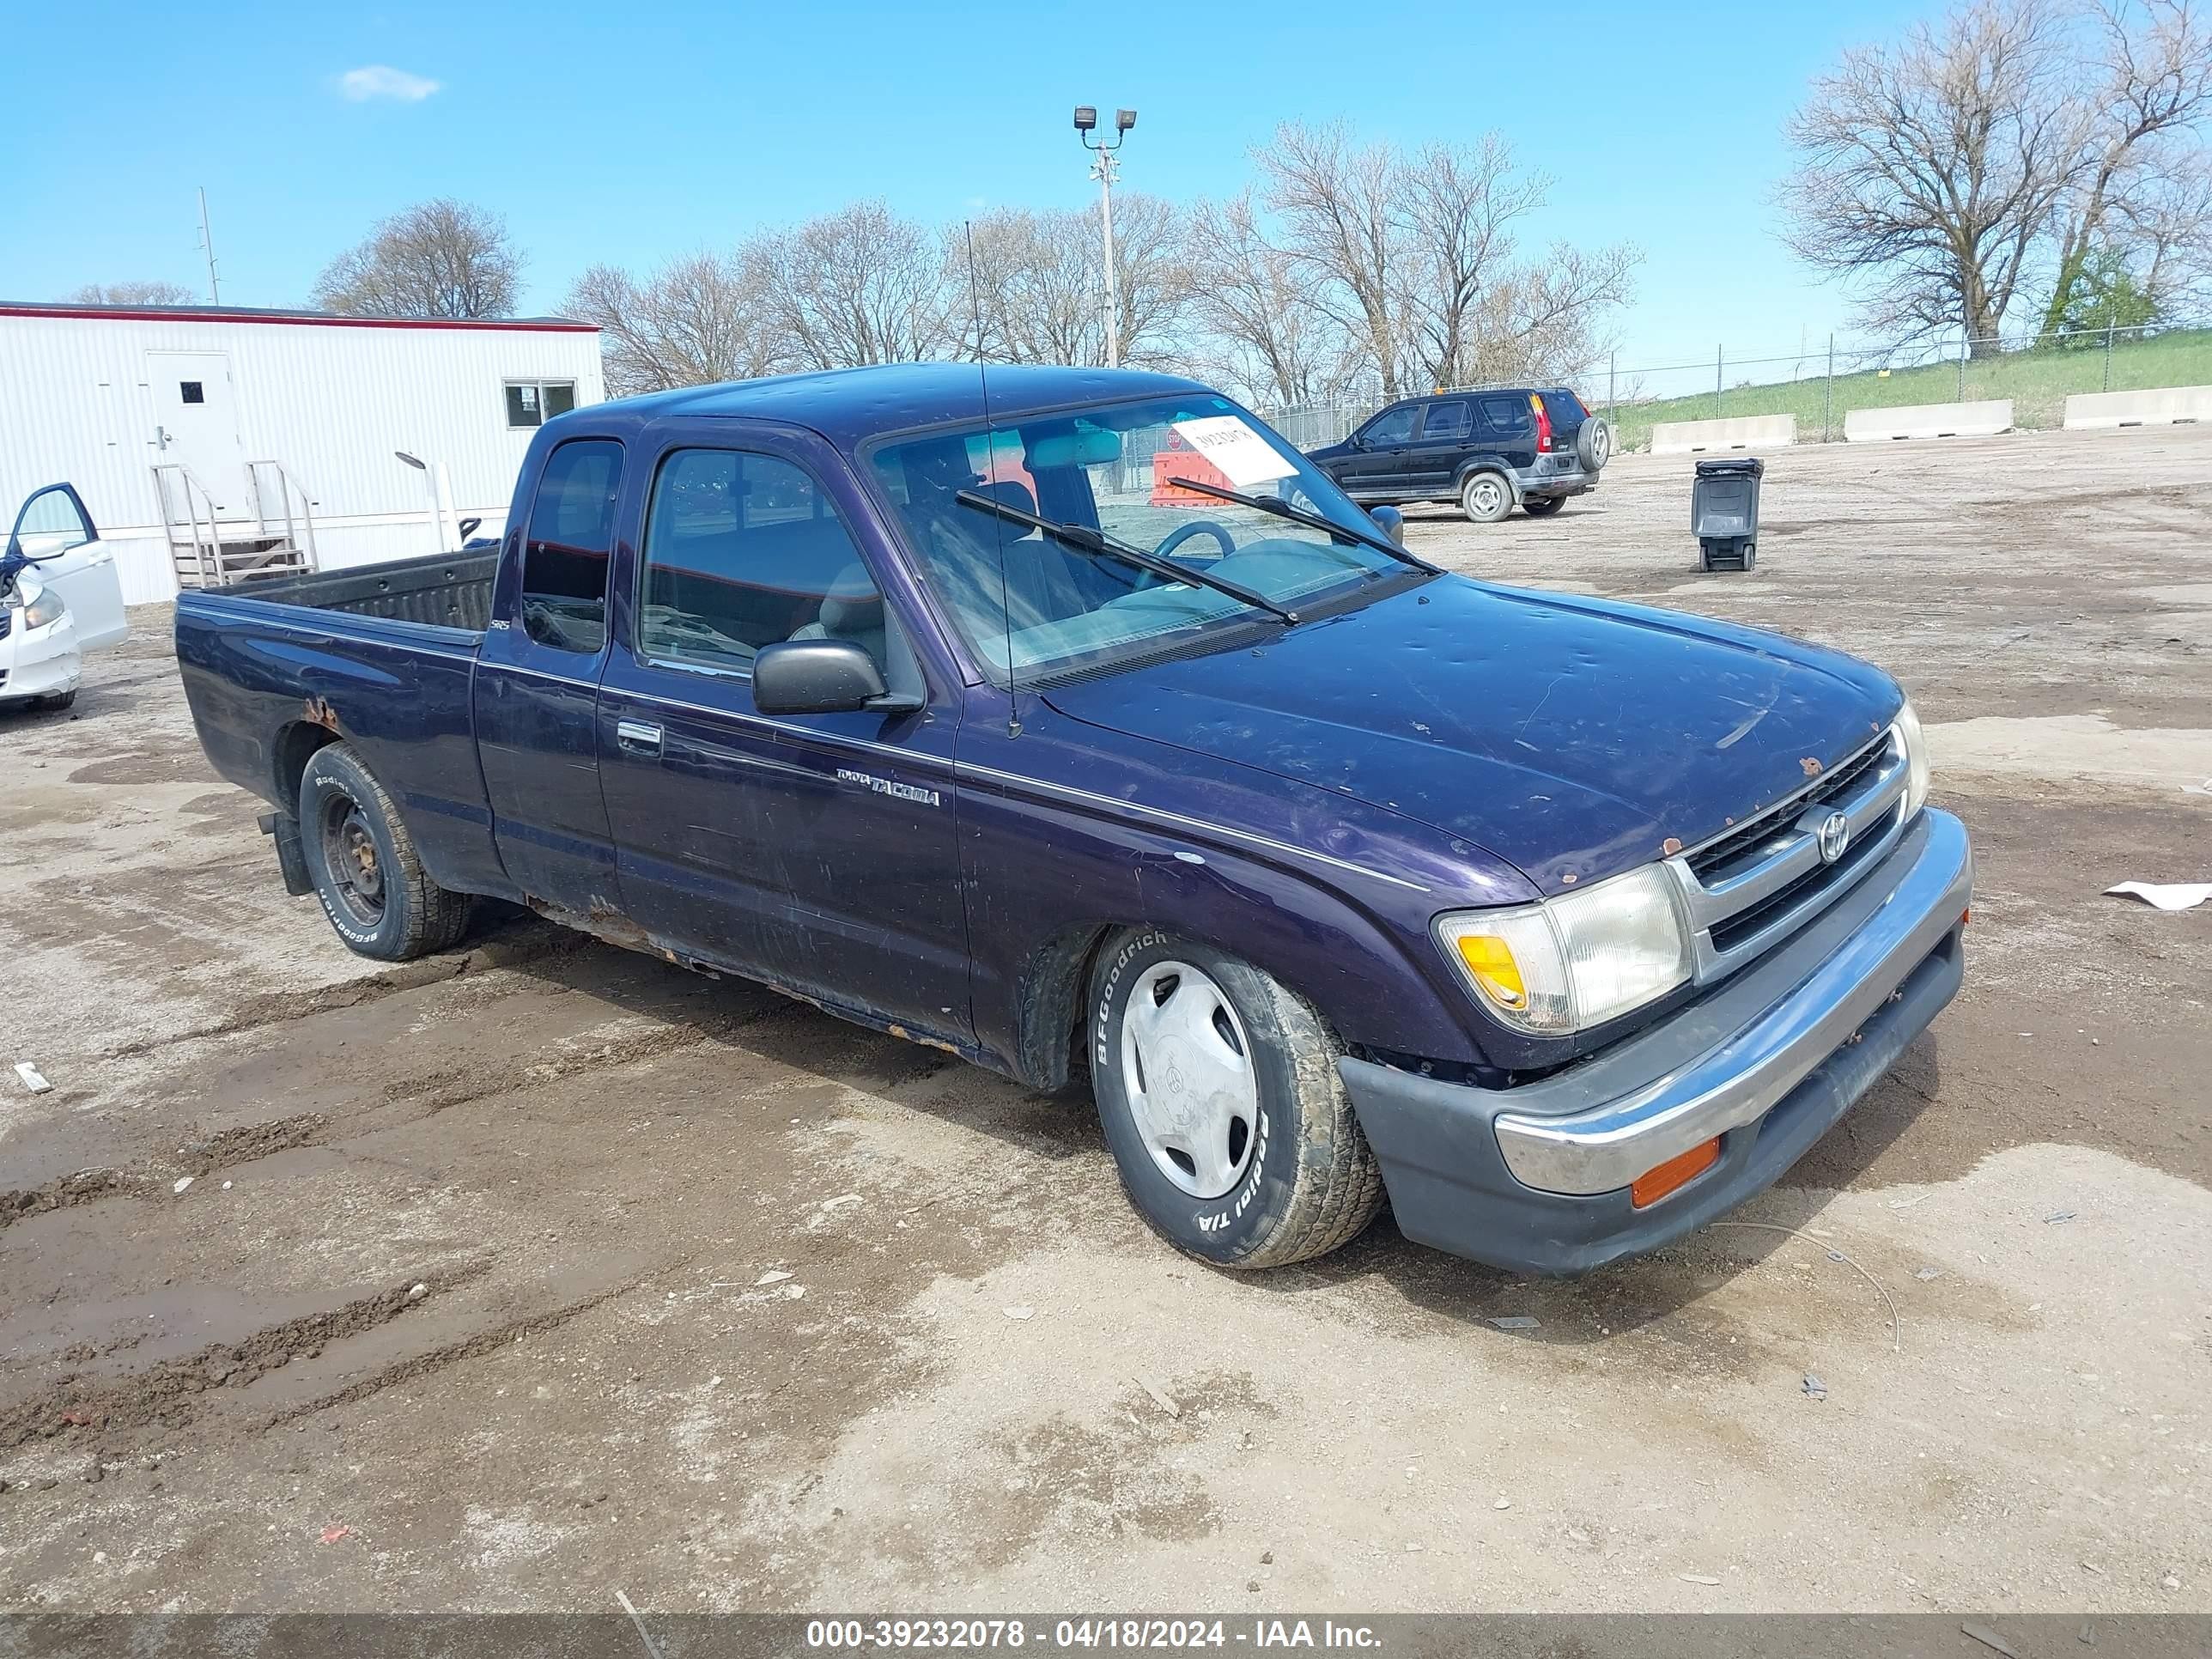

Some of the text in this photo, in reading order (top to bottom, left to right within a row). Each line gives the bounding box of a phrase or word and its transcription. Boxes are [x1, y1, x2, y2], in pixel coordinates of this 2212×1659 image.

[1168, 434, 1181, 443] STOP
[314, 775, 349, 794] Radial
[836, 769, 939, 806] TOYOTA TACOMA
[319, 887, 378, 944] BFGoodrich
[1097, 930, 1167, 1066] BFGoodrich
[1198, 1109, 1270, 1232] Radial T/A
